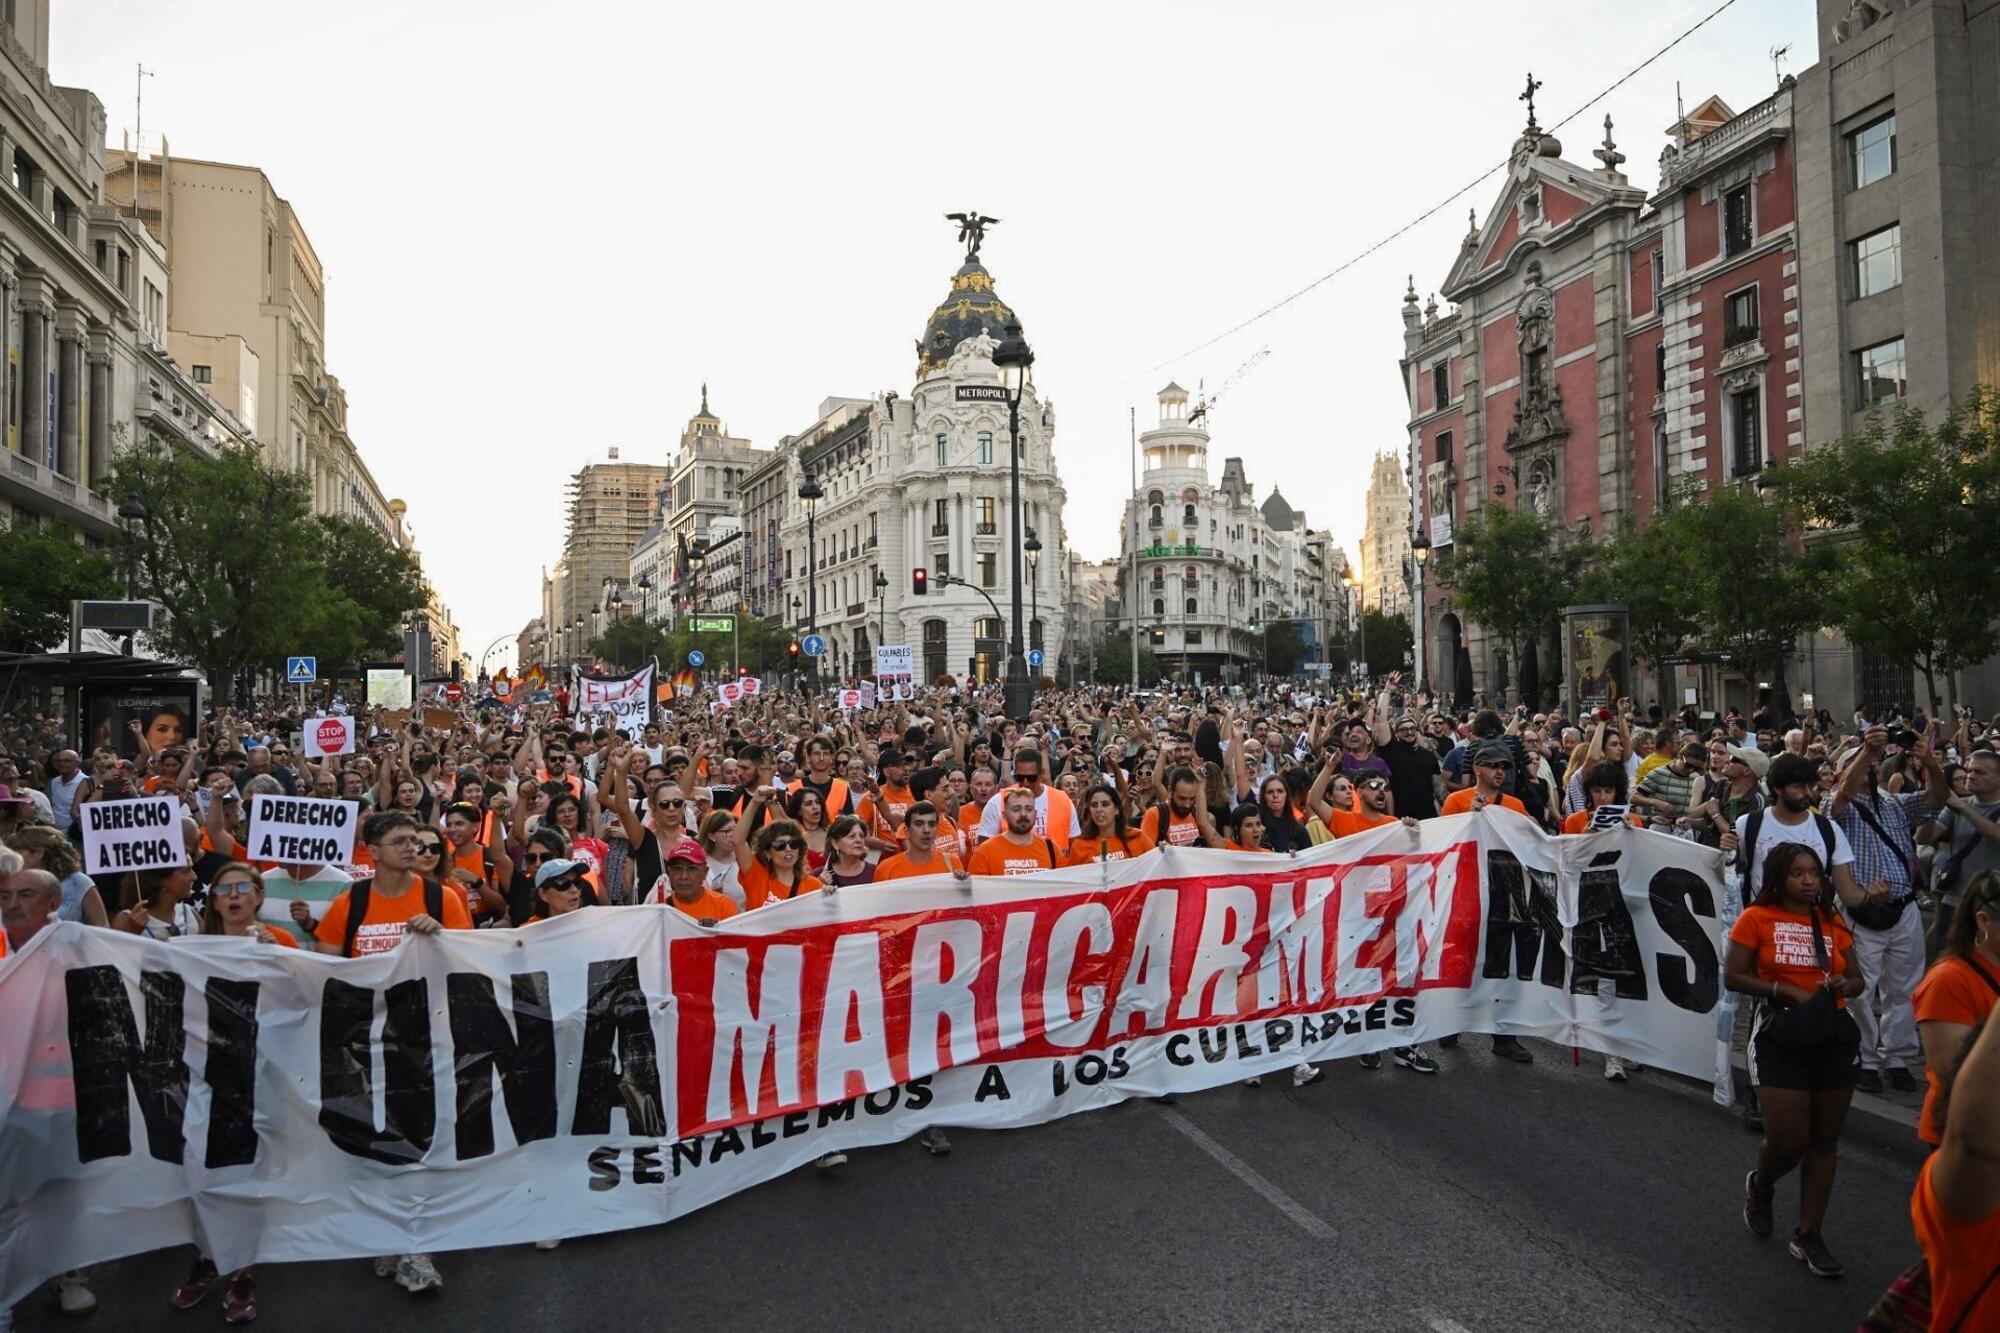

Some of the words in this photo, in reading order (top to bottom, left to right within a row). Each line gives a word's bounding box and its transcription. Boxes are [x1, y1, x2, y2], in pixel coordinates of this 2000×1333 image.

[958, 388, 1006, 399] METROPOLI
[319, 727, 344, 737] STOP
[89, 801, 171, 831] DERECHO
[260, 800, 348, 828] DERECHO
[99, 843, 112, 868] A
[112, 838, 178, 867] TECHO.
[259, 834, 272, 857] A
[278, 834, 344, 862] TECHO.
[358, 922, 408, 936] SINDICAT
[1774, 922, 1813, 934] SINDICAT
[358, 938, 371, 950] DE
[1775, 954, 1787, 964] DE
[65, 965, 260, 1169] NI
[318, 956, 667, 1166] UNA
[706, 851, 1460, 1124] MARICARMEN
[1483, 850, 1719, 1014] MÁS
[975, 1064, 1011, 1102] A
[1052, 1047, 1128, 1097] LOS
